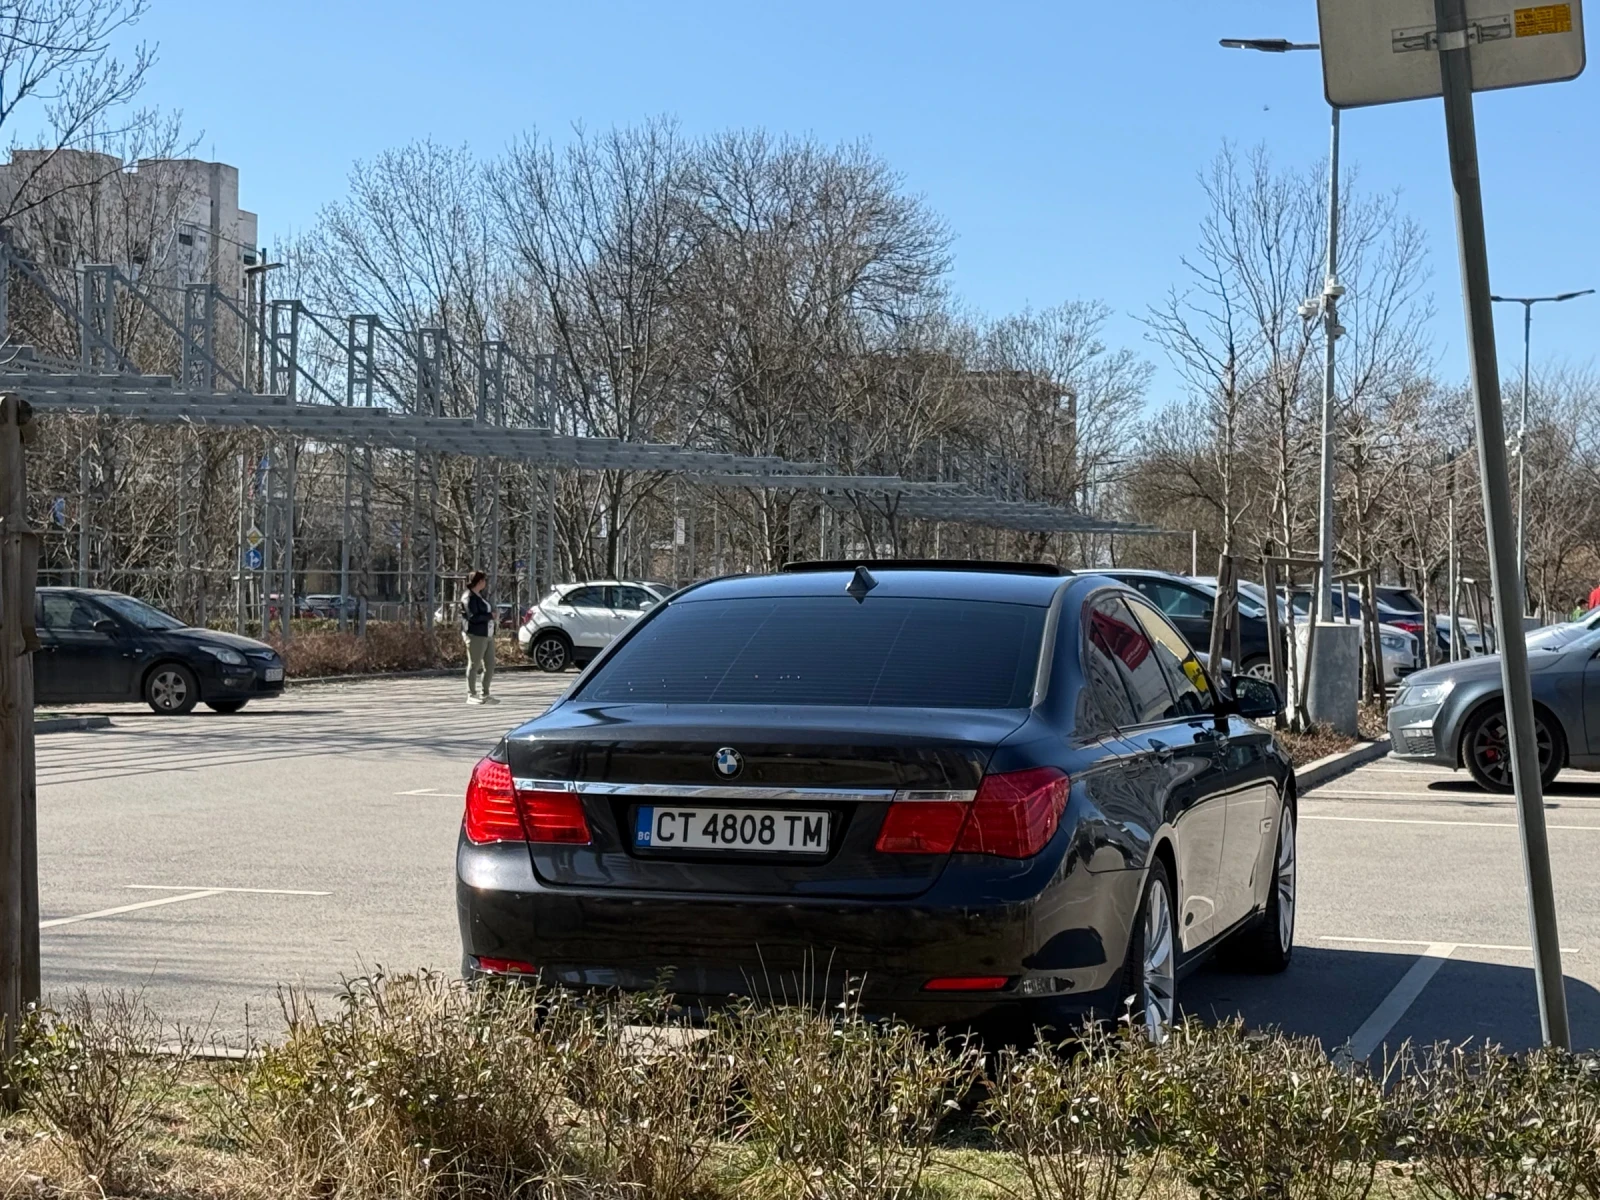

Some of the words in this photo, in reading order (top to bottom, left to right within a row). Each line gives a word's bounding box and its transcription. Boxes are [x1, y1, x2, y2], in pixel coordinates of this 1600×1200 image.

[637, 831, 650, 841] BG
[656, 812, 696, 842] CT
[702, 813, 775, 845] 4808
[784, 816, 823, 847] TM
